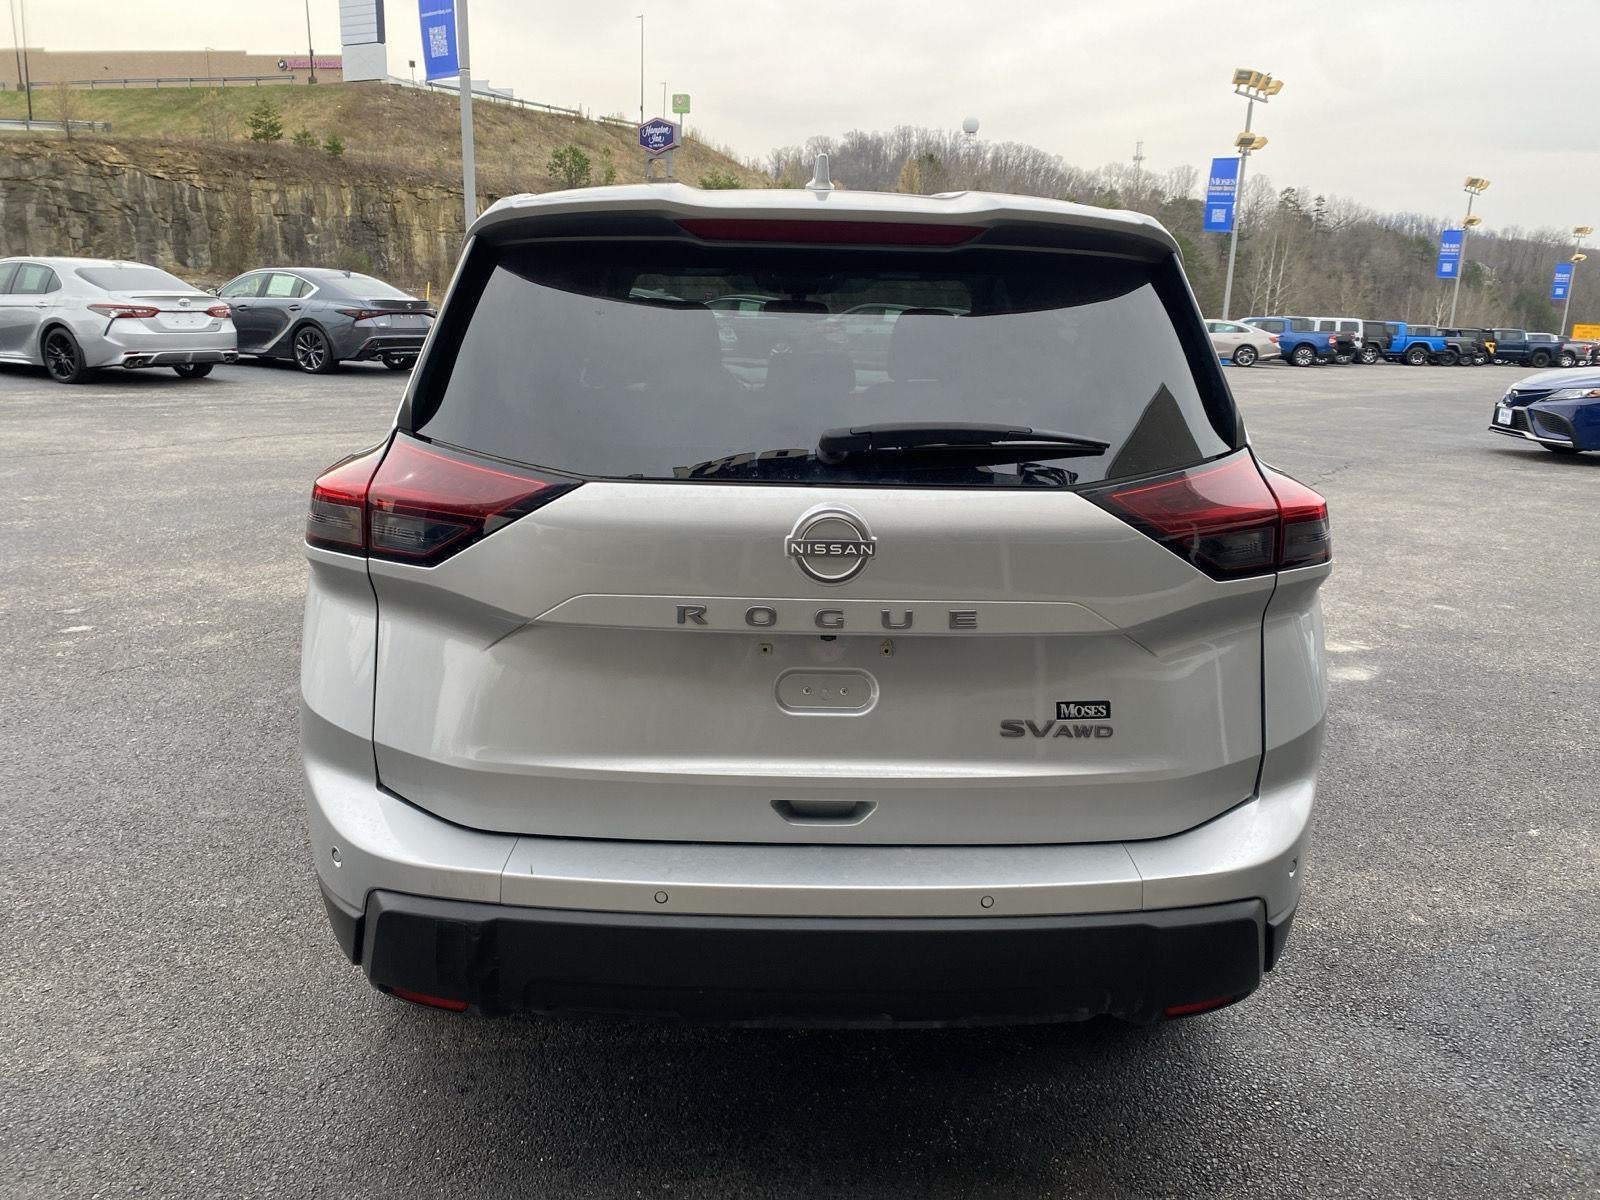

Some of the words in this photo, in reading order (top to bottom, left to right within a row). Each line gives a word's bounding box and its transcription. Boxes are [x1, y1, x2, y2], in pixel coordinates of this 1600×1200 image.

[791, 543, 873, 555] NISSAN
[676, 604, 978, 630] ROGUE
[1060, 703, 1107, 718] MOSES
